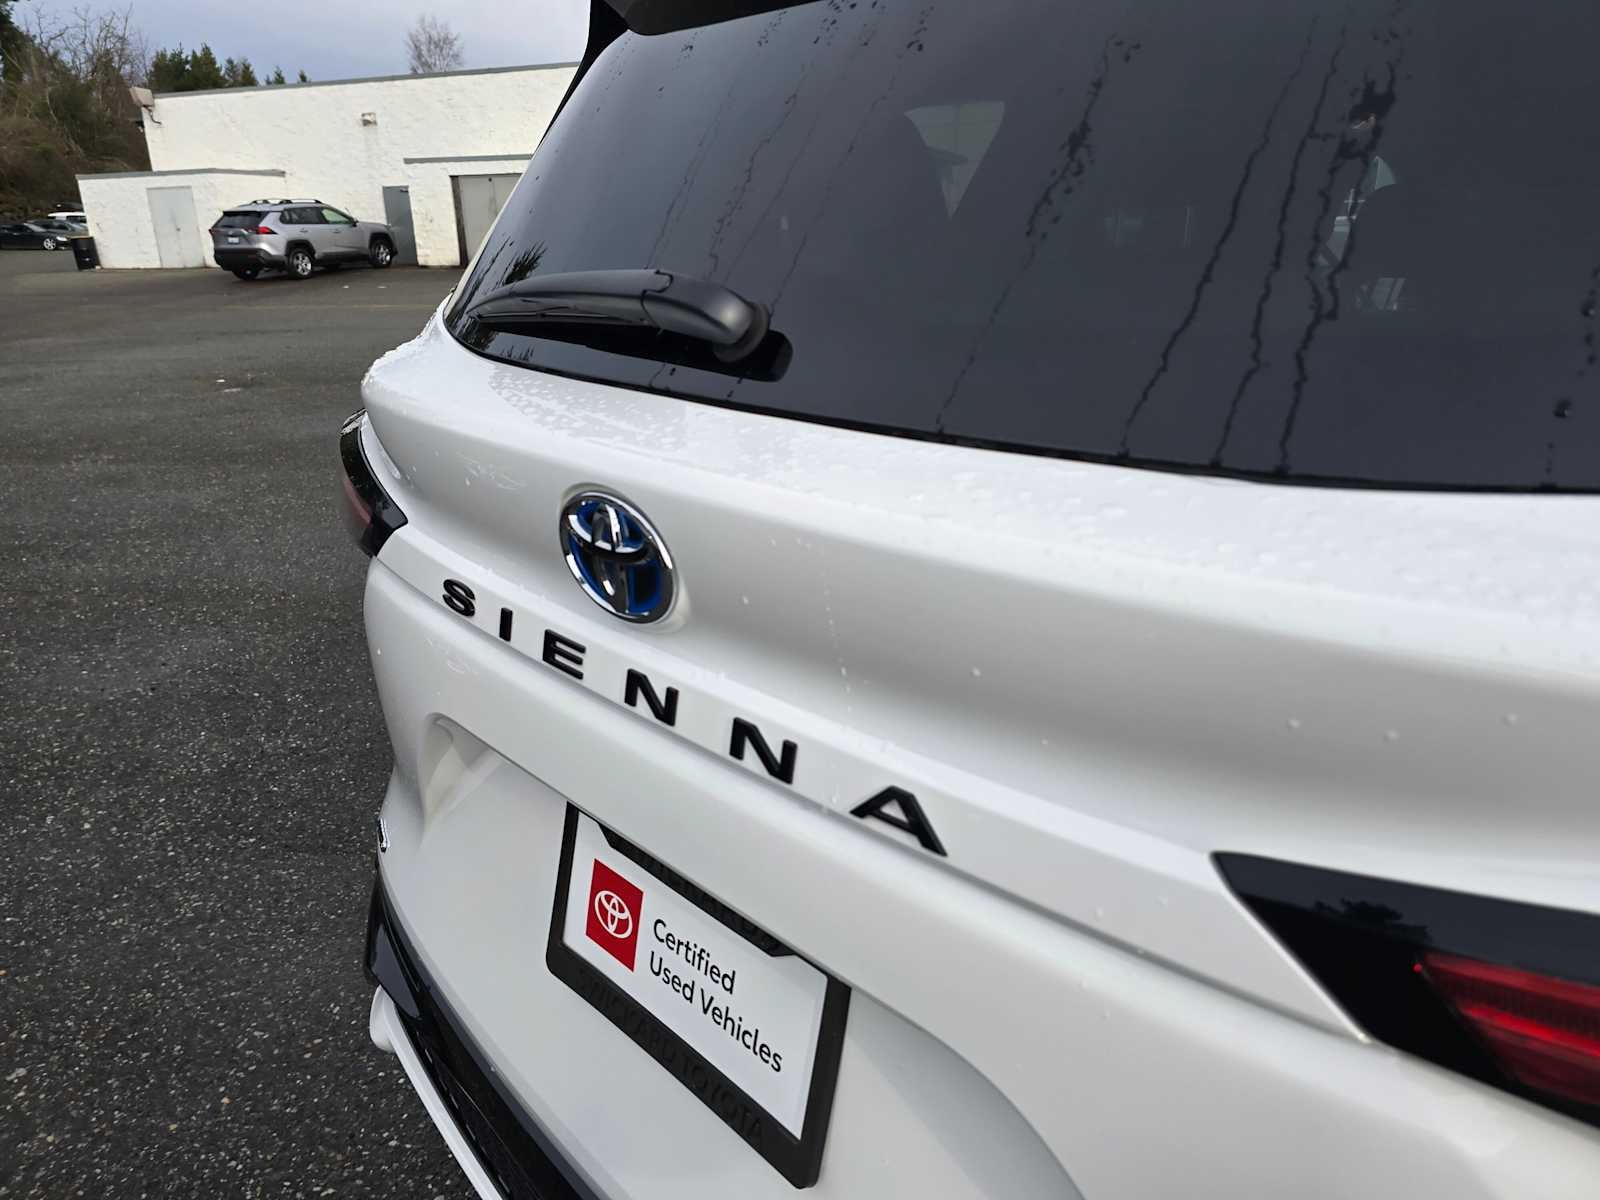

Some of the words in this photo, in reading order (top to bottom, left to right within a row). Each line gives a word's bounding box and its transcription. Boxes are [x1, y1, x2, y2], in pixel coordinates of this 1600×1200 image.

[442, 578, 948, 857] SIENNA
[653, 918, 736, 994] Certified
[649, 950, 695, 1004] Used
[700, 987, 783, 1073] Vehicles
[681, 1050, 763, 1147] TOYOTA
